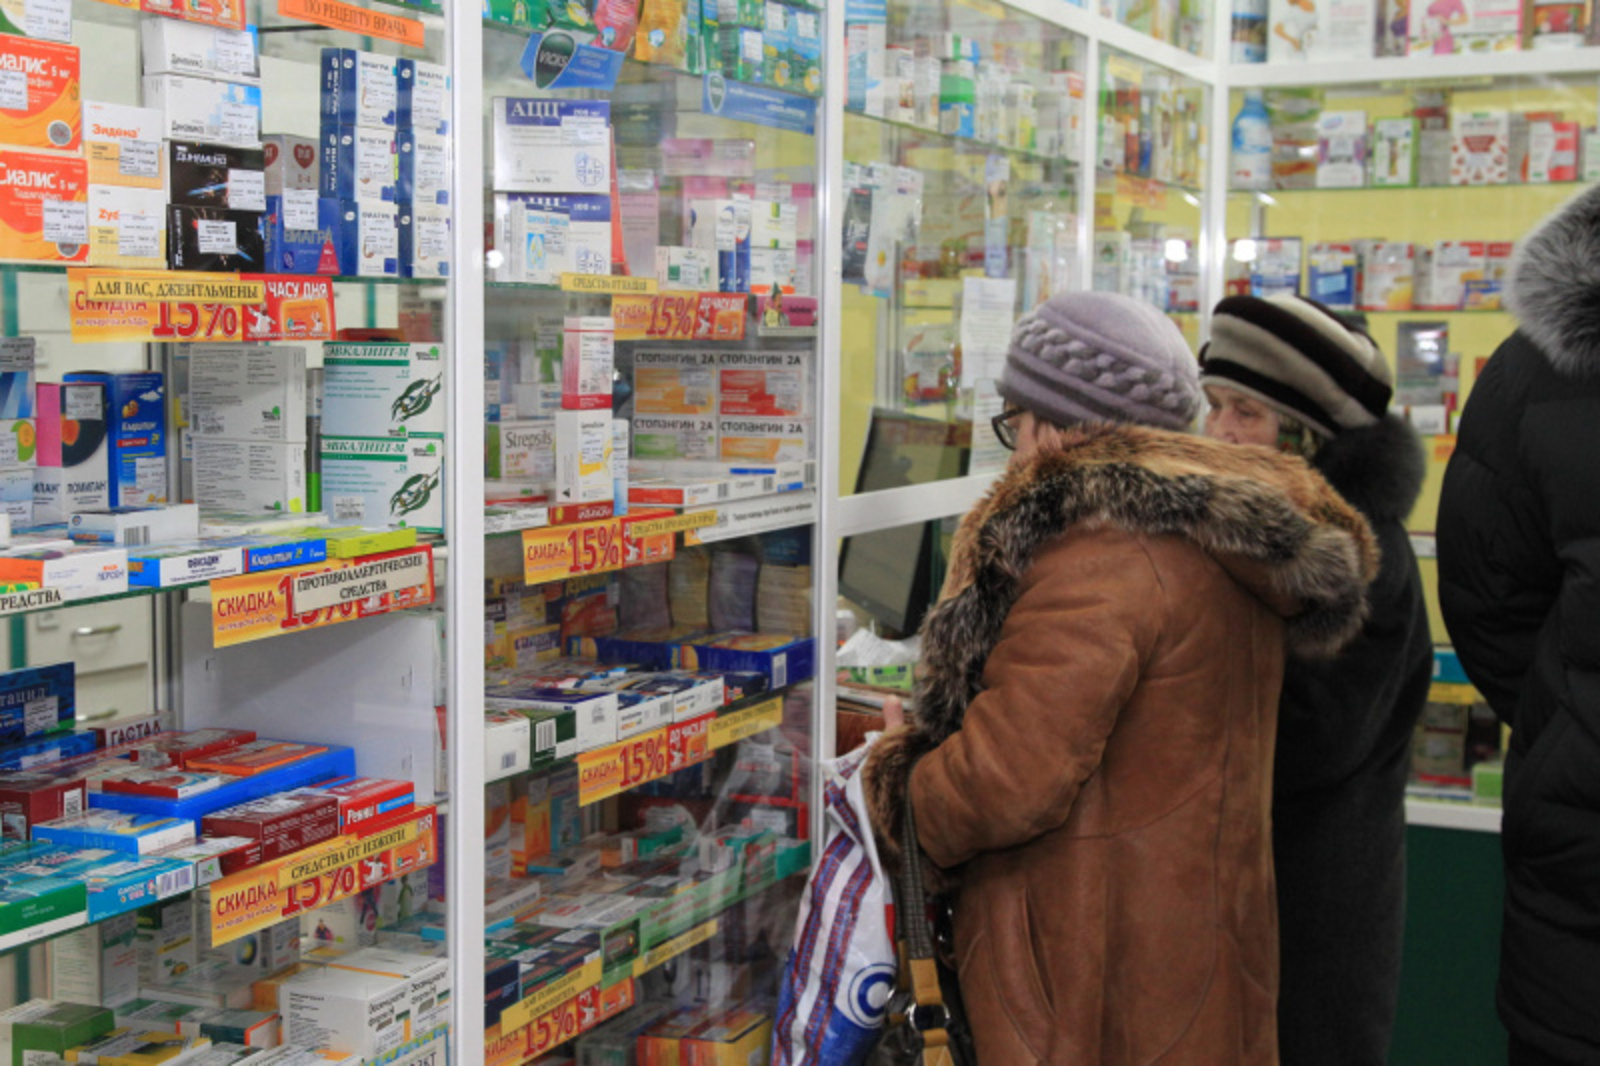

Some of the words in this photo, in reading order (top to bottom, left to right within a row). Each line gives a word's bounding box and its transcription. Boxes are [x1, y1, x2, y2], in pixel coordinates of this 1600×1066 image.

[323, 4, 370, 28] РЕЦЕПТУ
[373, 16, 407, 37] ВРАЧА
[539, 51, 569, 67] VICKS
[511, 101, 560, 119] АЦЦ
[94, 281, 121, 296] ДЛЯ
[124, 281, 154, 298] ВАС,
[156, 282, 259, 299] ДЖЕНТЛЬМЕНЫ
[268, 281, 299, 298] ЧАСУ
[303, 282, 328, 299] ДНЯ
[645, 295, 696, 337] 15%
[505, 430, 553, 450] Strepsils
[527, 542, 566, 561] СКИДКА
[567, 523, 620, 573] 15%
[339, 579, 388, 600] СРЕДСТВА
[217, 589, 276, 618] СКИДКА
[110, 720, 161, 746] ГАСТАЛ
[581, 759, 618, 784] СКИДКА
[619, 734, 665, 787] 15%
[291, 851, 345, 880] СРЕДСТВА
[347, 846, 361, 860] ОТ
[363, 831, 406, 854] ИЗЖОГИ
[216, 881, 277, 917] СКИДКА
[522, 1009, 575, 1059] 15%
